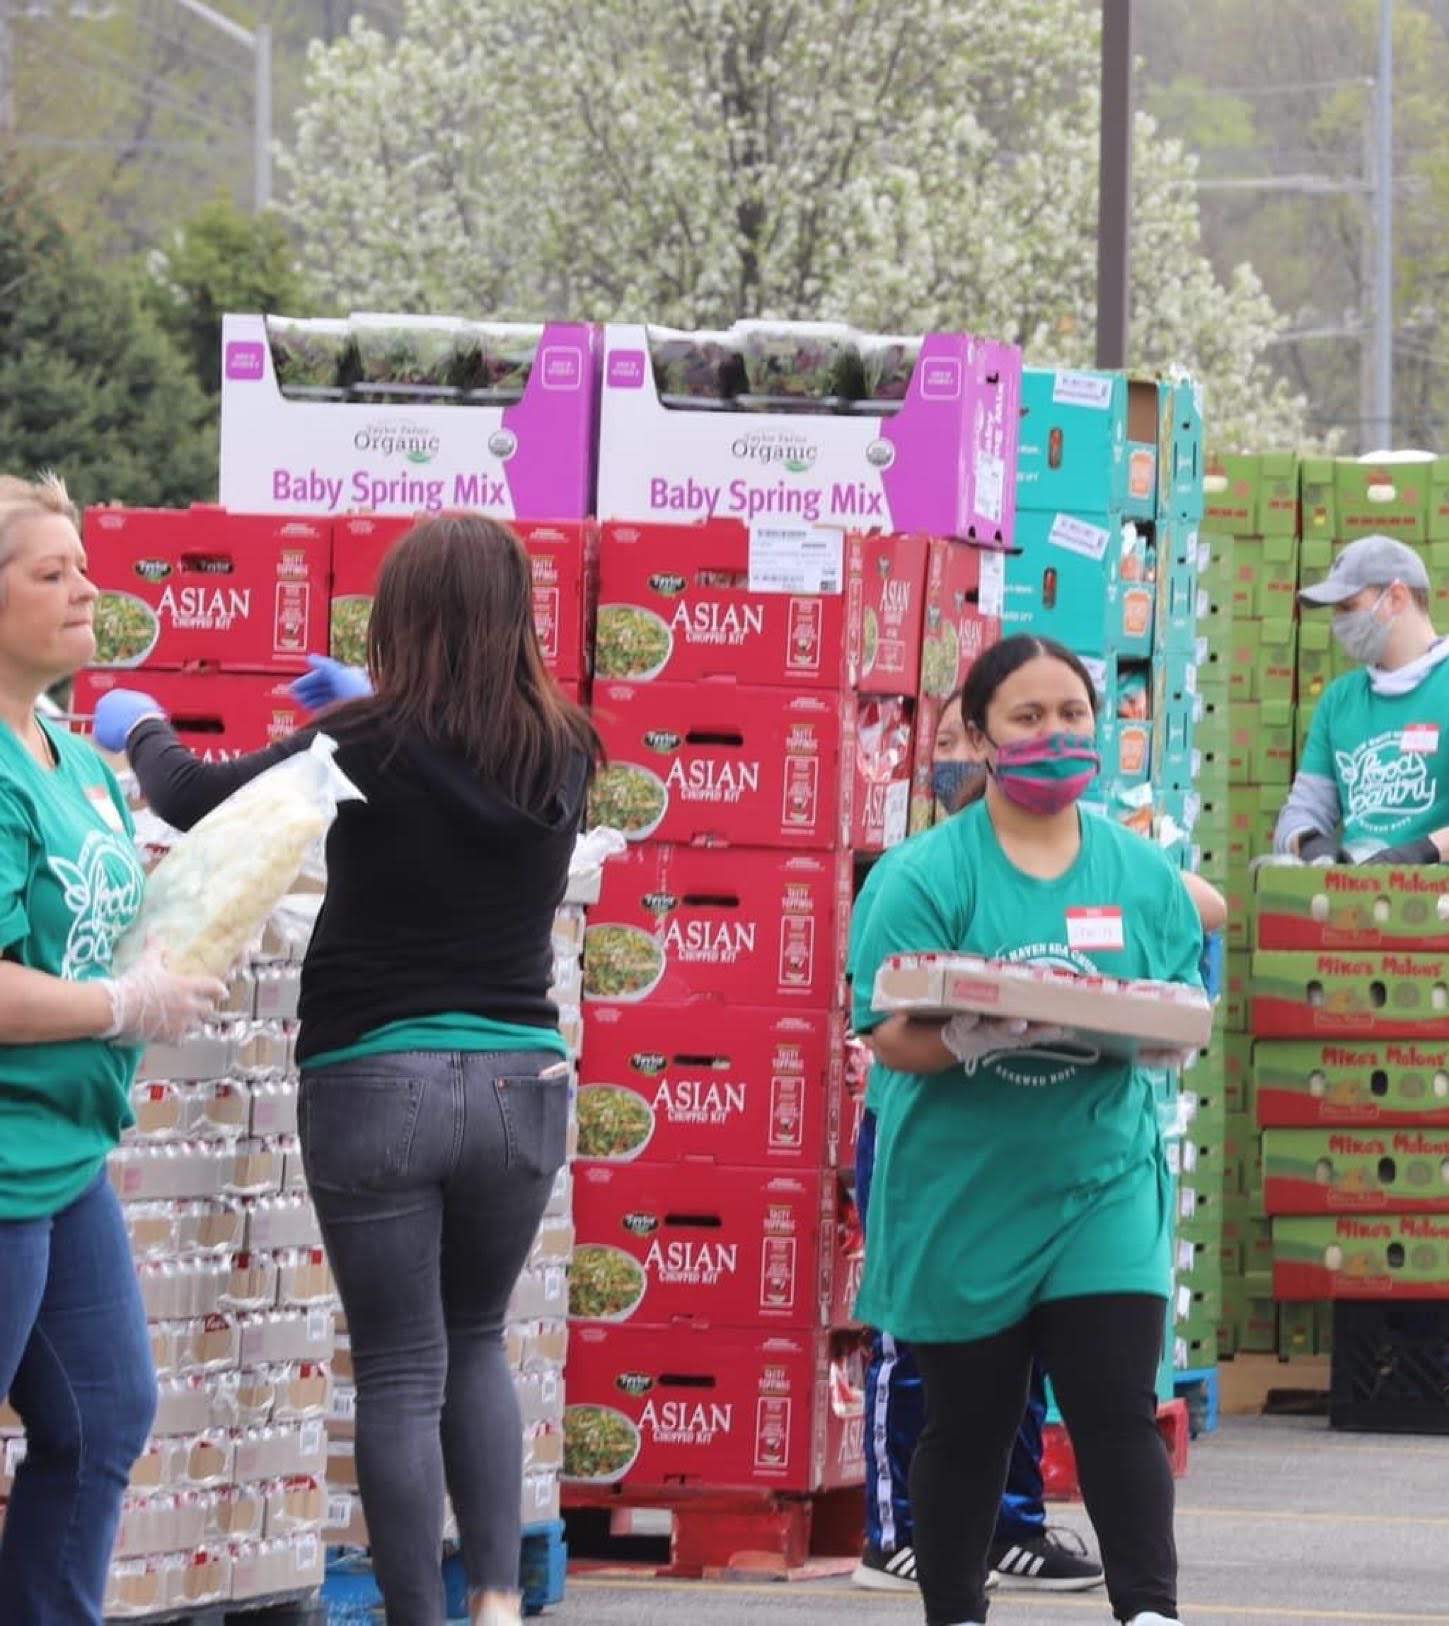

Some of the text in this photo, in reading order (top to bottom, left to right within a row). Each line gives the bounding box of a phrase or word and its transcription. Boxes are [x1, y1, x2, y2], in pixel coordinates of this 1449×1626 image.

[354, 430, 440, 454] Organic
[732, 439, 817, 464] Organic
[273, 469, 505, 513] Baby Spring Mix
[651, 478, 883, 521] Baby Spring Mix
[157, 584, 251, 619] ASIAN
[672, 599, 764, 634] ASIAN
[666, 757, 759, 792] ASIAN
[664, 918, 757, 952] ASIAN
[1381, 954, 1444, 978] Melons
[1386, 1044, 1449, 1067] Melons
[653, 1079, 747, 1114] ASIAN
[644, 1239, 739, 1274] ASIAN
[638, 1399, 733, 1433] ASIAN
